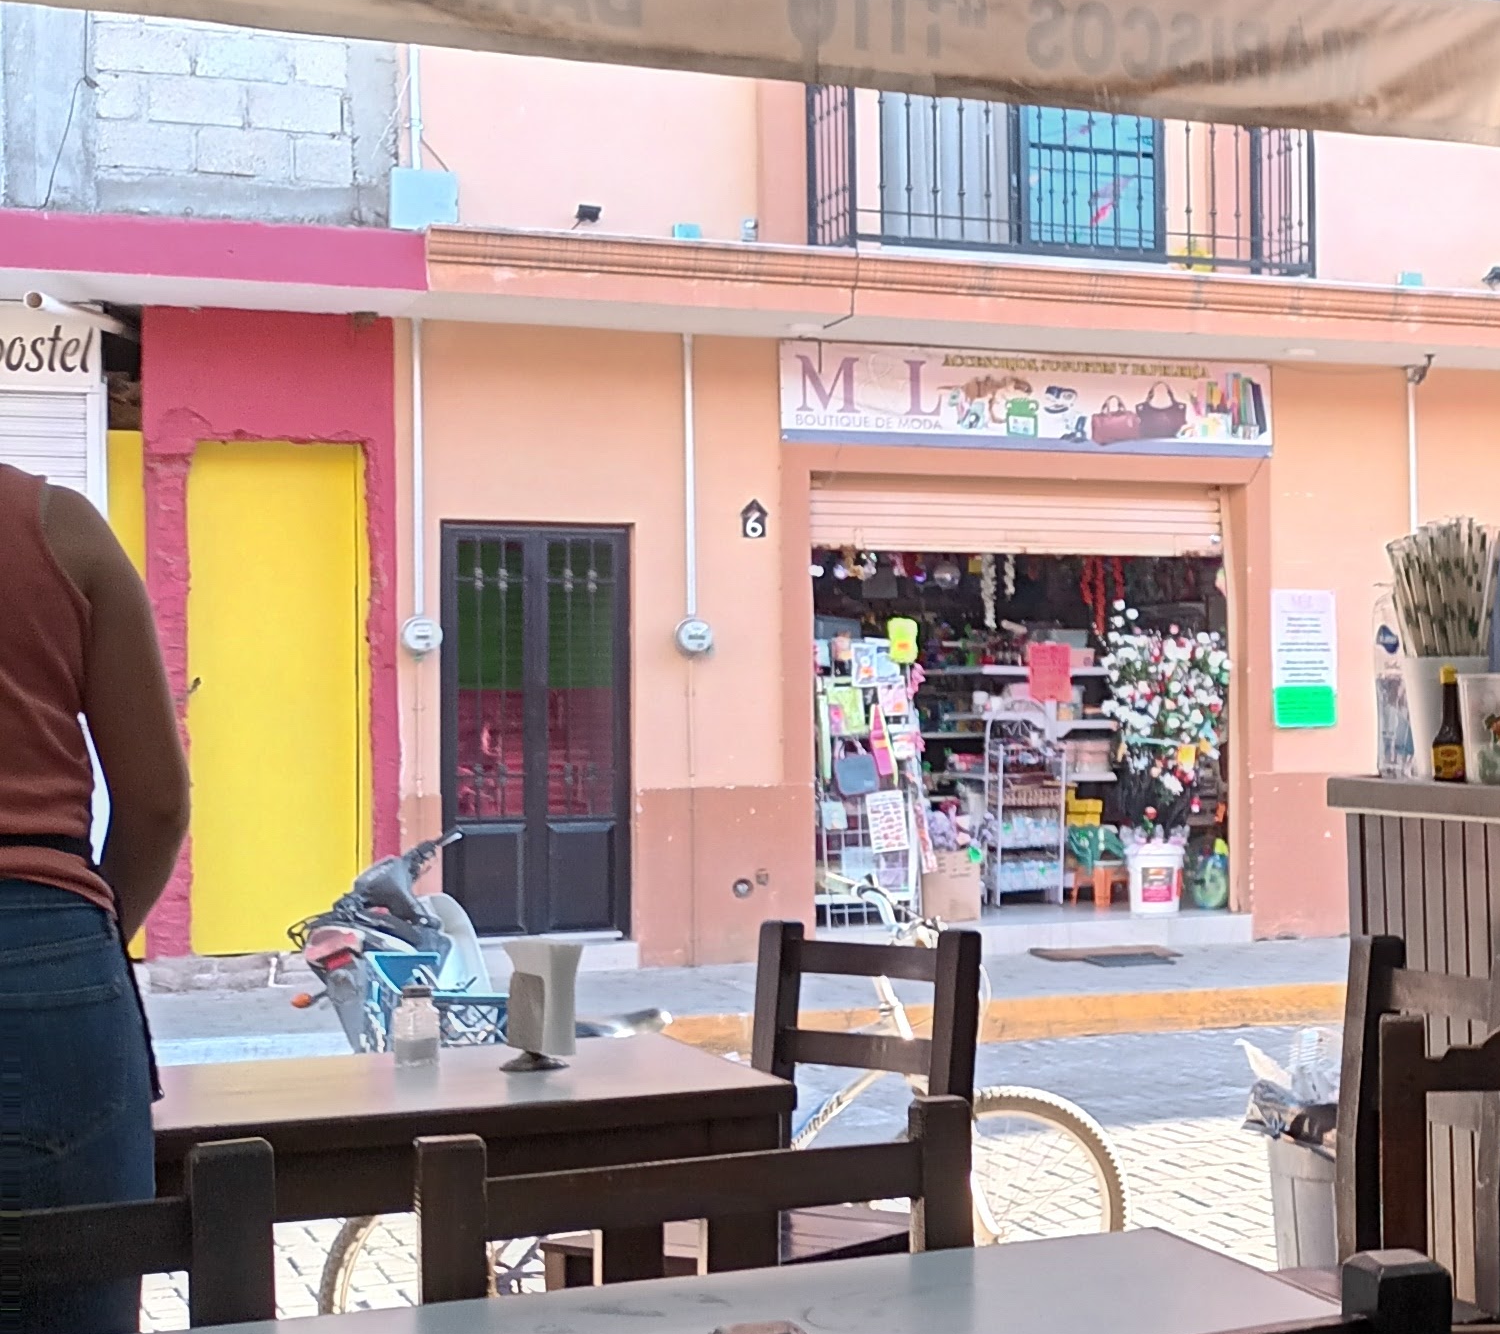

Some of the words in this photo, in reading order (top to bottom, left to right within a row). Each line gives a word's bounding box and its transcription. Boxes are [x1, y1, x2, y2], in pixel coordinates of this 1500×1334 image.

[0, 324, 93, 373] ostel
[795, 414, 870, 428] BOUTIQUE
[874, 417, 892, 429] DE
[899, 418, 943, 431] MODA
[746, 512, 763, 538] 6
